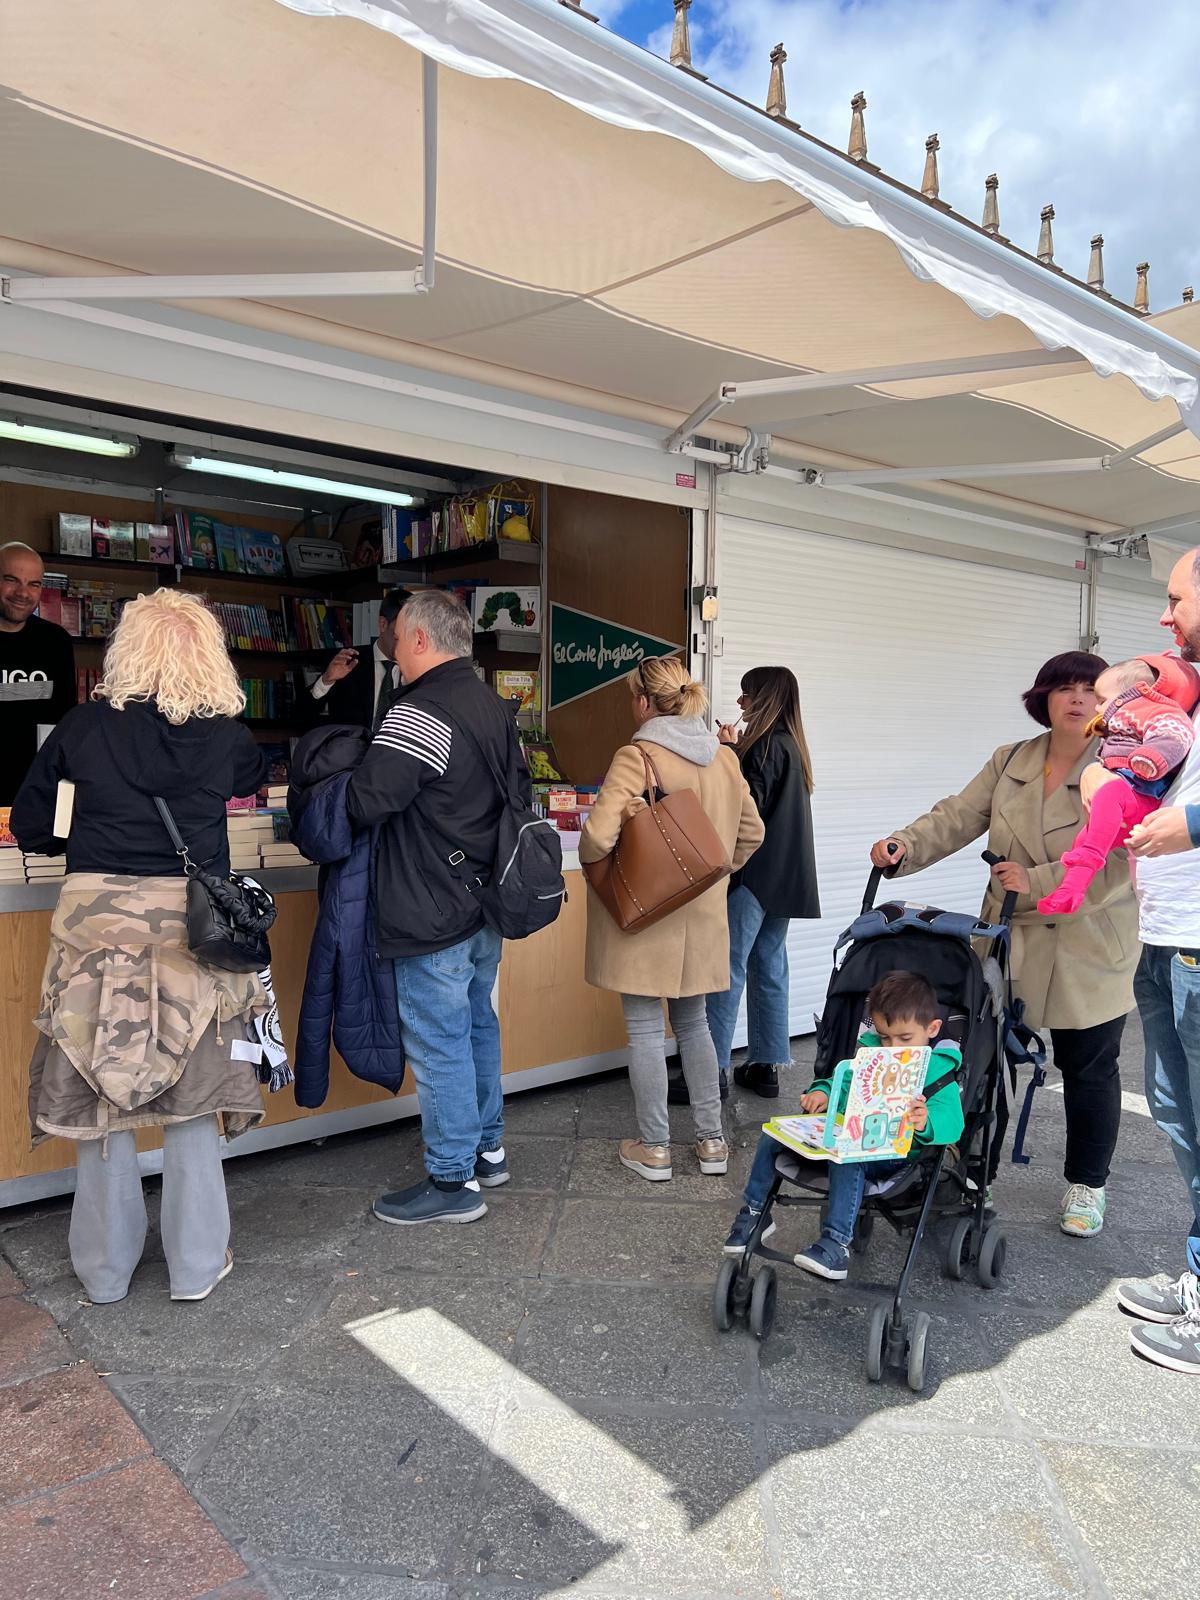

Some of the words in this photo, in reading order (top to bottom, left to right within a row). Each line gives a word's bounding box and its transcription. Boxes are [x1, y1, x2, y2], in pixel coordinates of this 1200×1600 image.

[553, 642, 566, 663] El
[566, 642, 596, 663] Corte
[597, 634, 644, 670] Inglés
